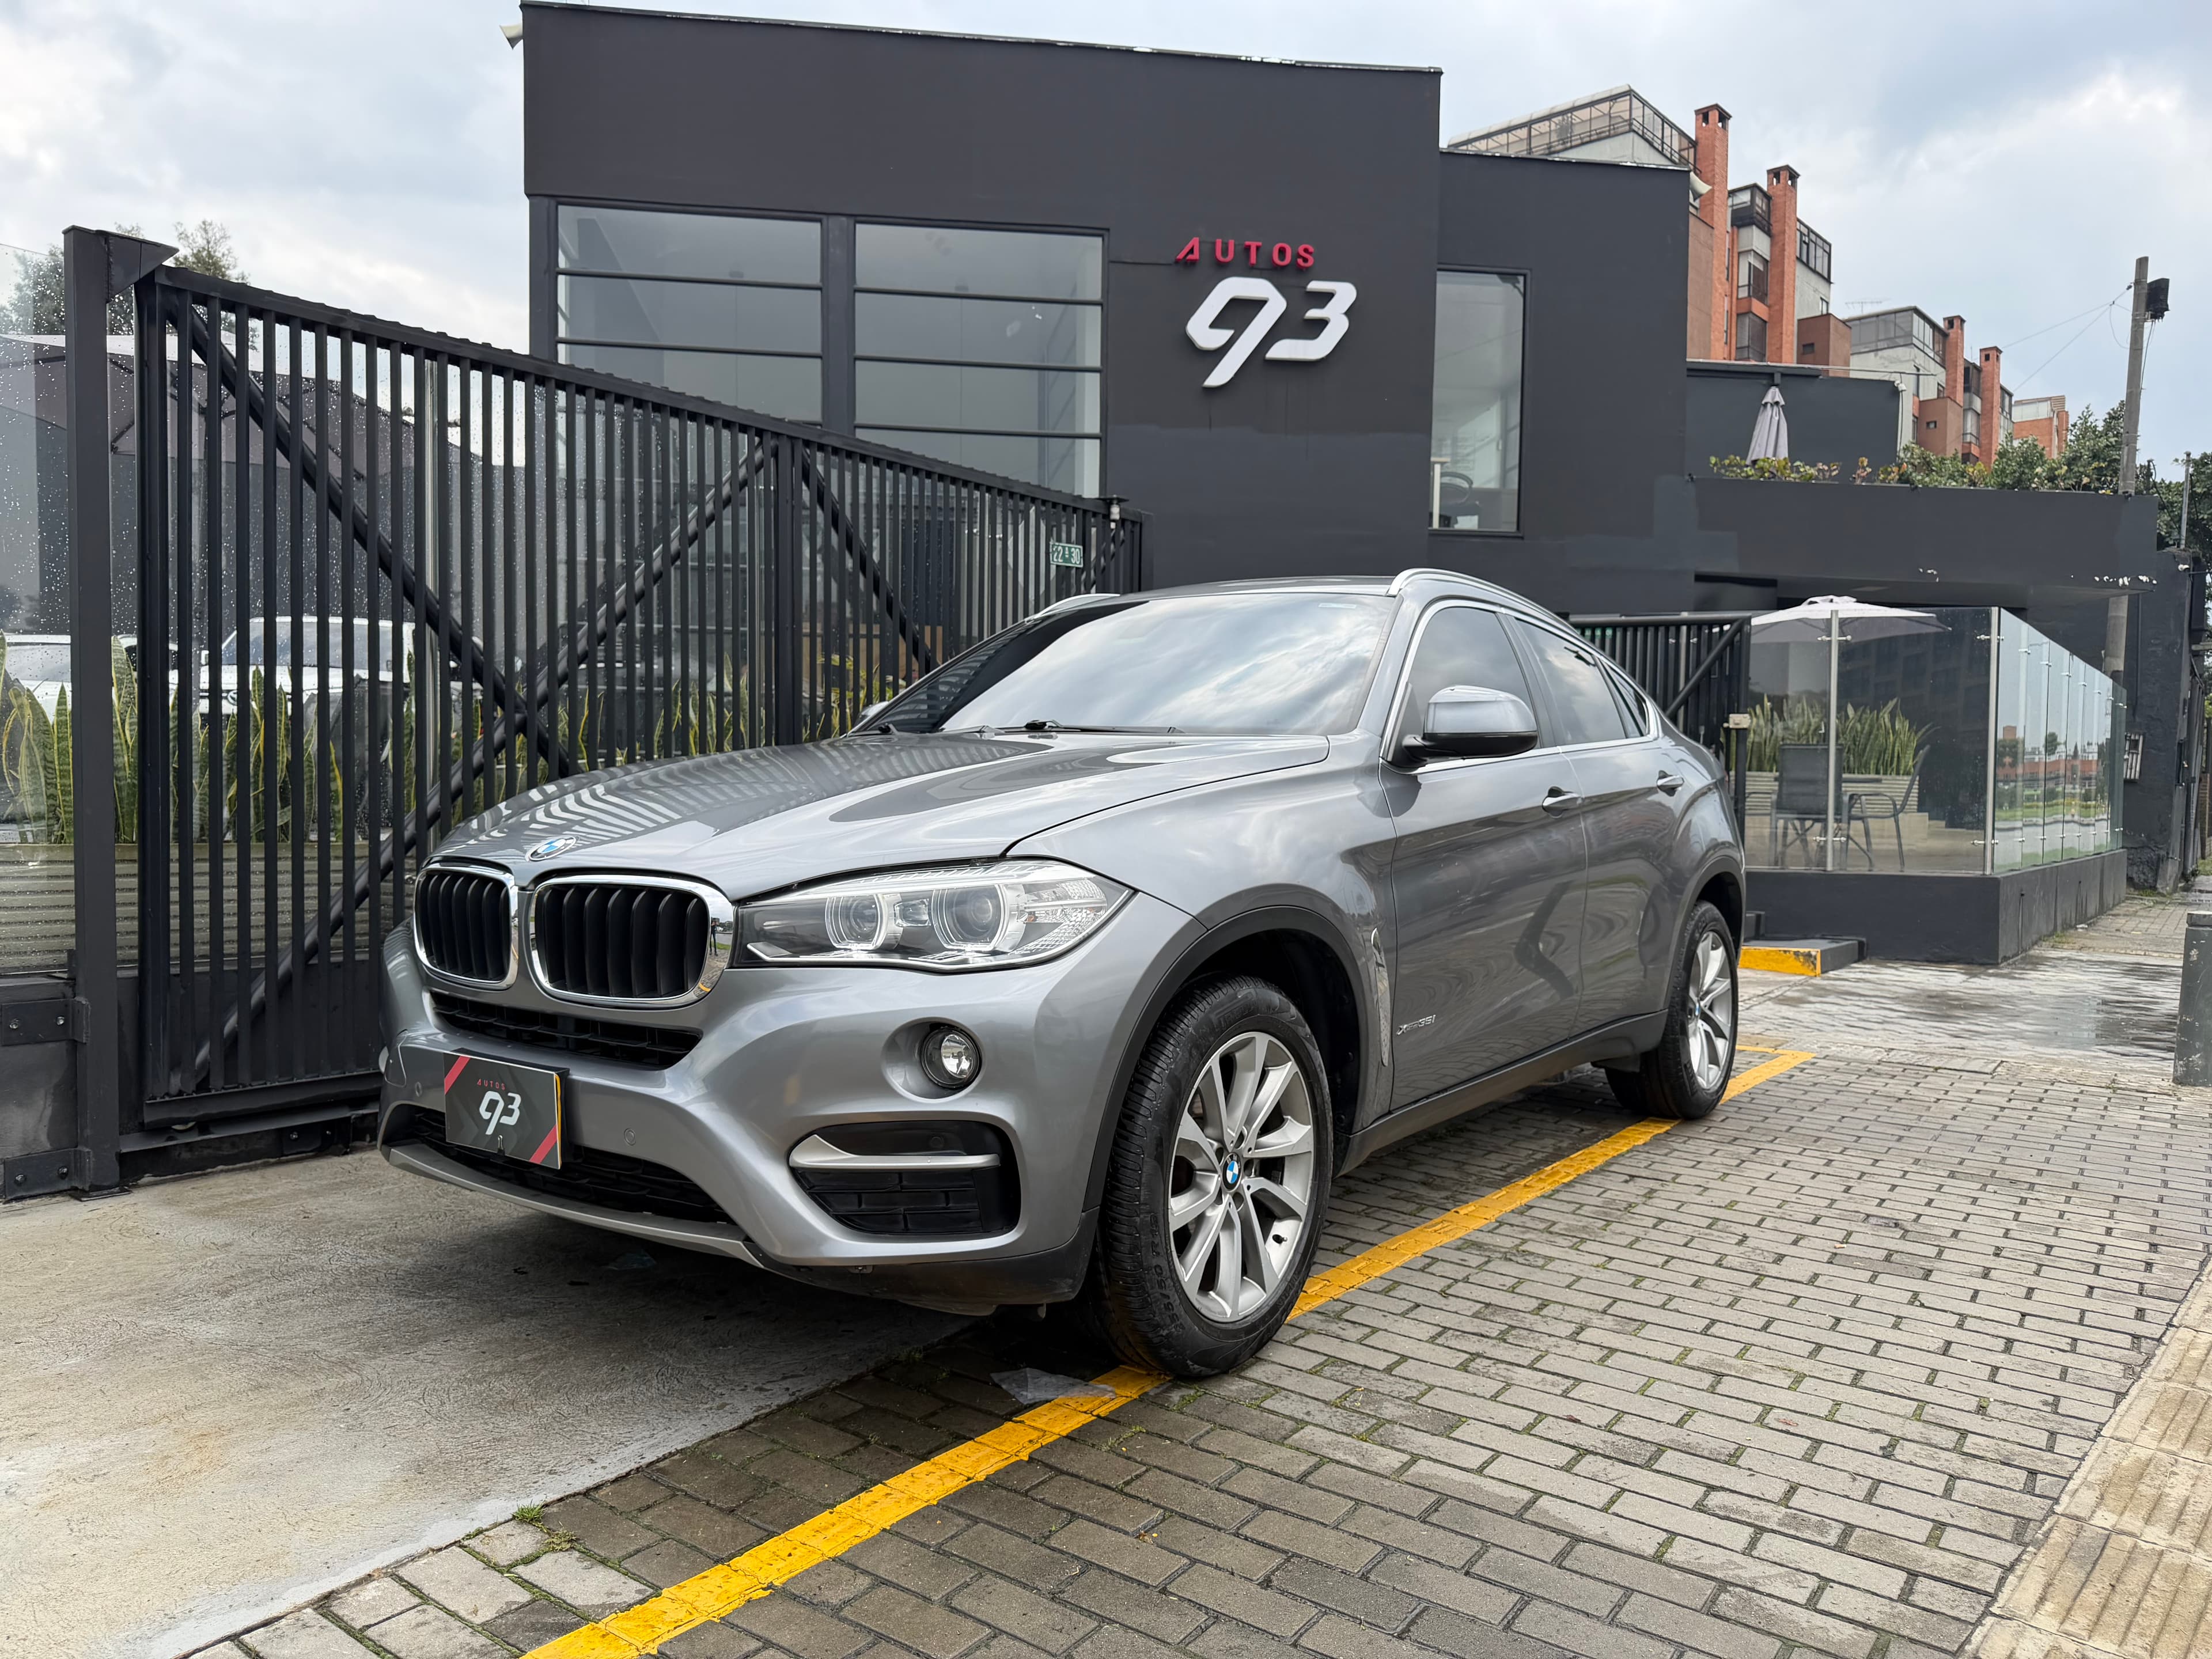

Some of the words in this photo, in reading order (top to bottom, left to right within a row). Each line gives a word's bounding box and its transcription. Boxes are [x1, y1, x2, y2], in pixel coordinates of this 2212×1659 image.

[1176, 237, 1315, 270] AUTOS
[1185, 276, 1357, 388] 93
[1071, 547, 1081, 565] 30
[477, 1078, 506, 1090] AUTOS
[479, 1090, 521, 1135] 93
